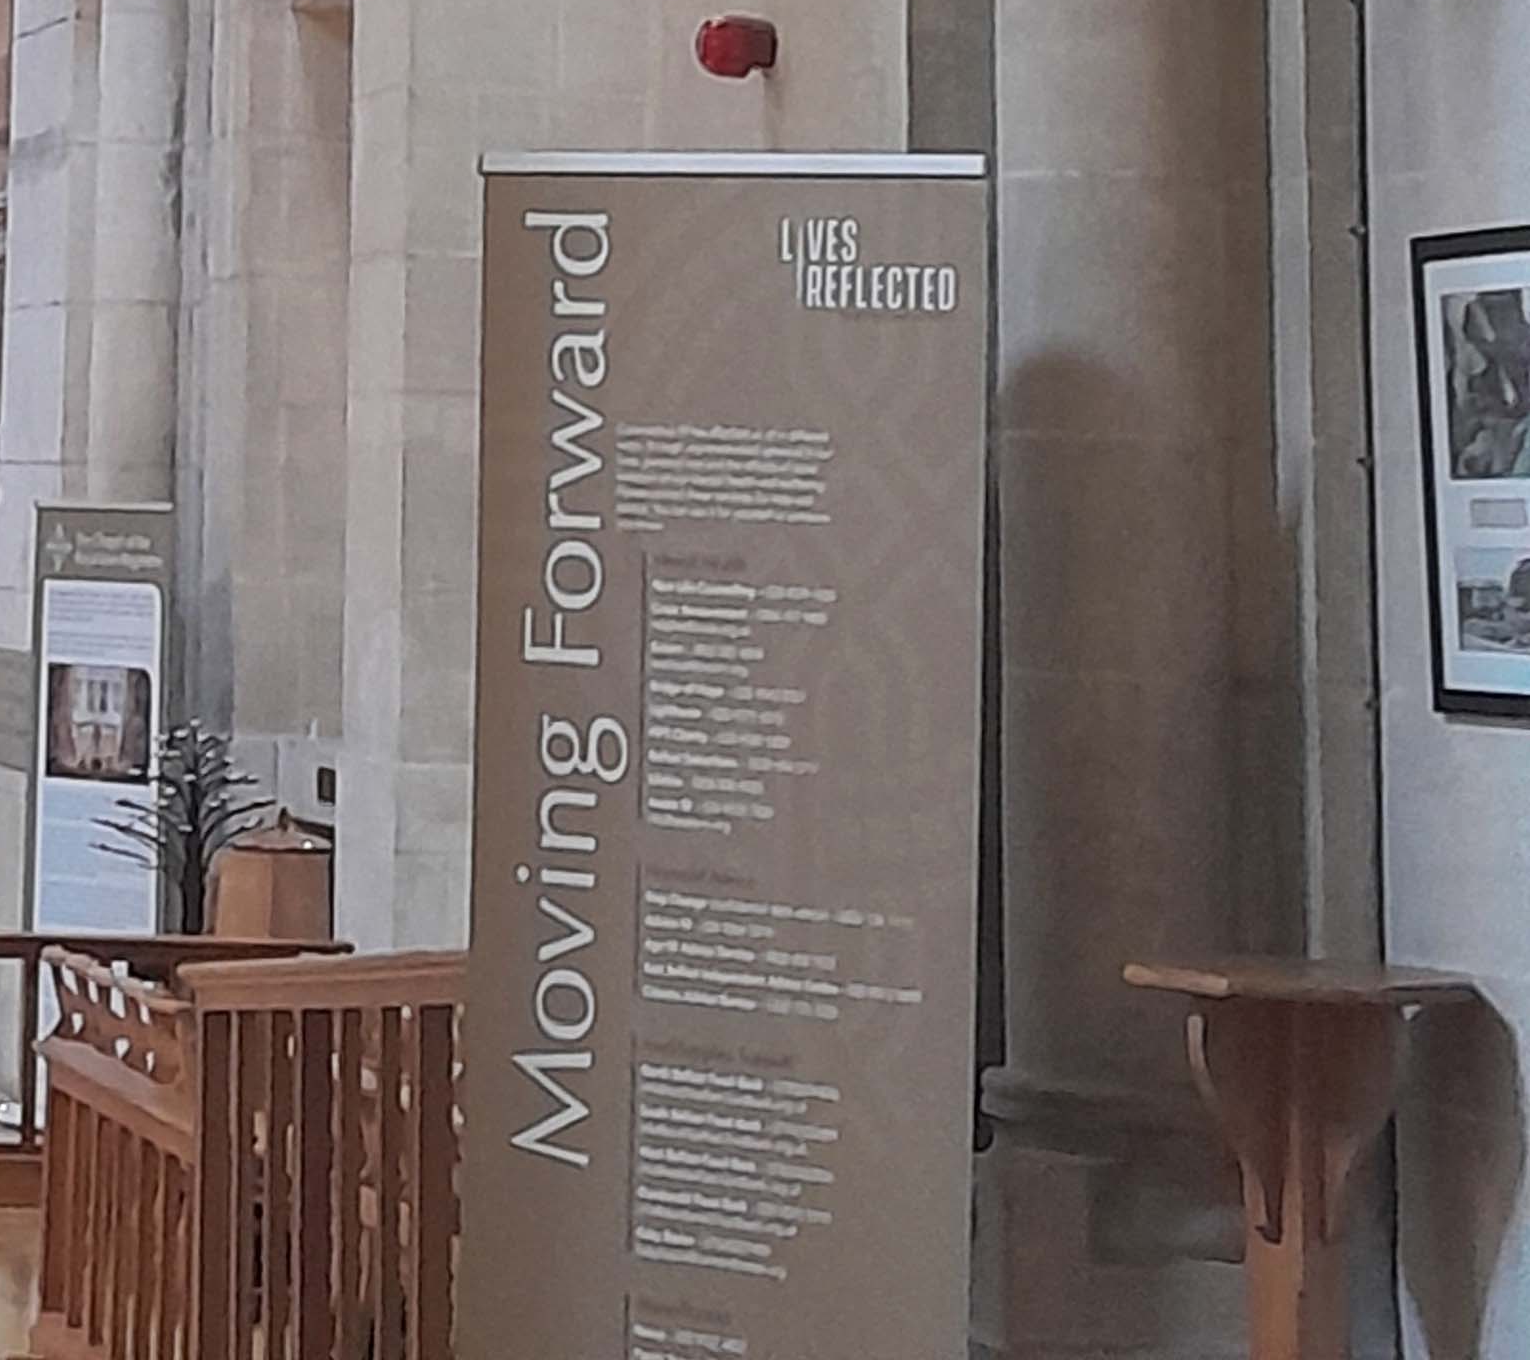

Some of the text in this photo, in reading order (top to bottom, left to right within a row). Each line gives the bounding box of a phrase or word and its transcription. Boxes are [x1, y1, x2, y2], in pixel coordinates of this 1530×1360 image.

[780, 217, 858, 280] LIVES
[805, 264, 956, 311] REFLECTED
[510, 211, 627, 1168] Moving Forward
